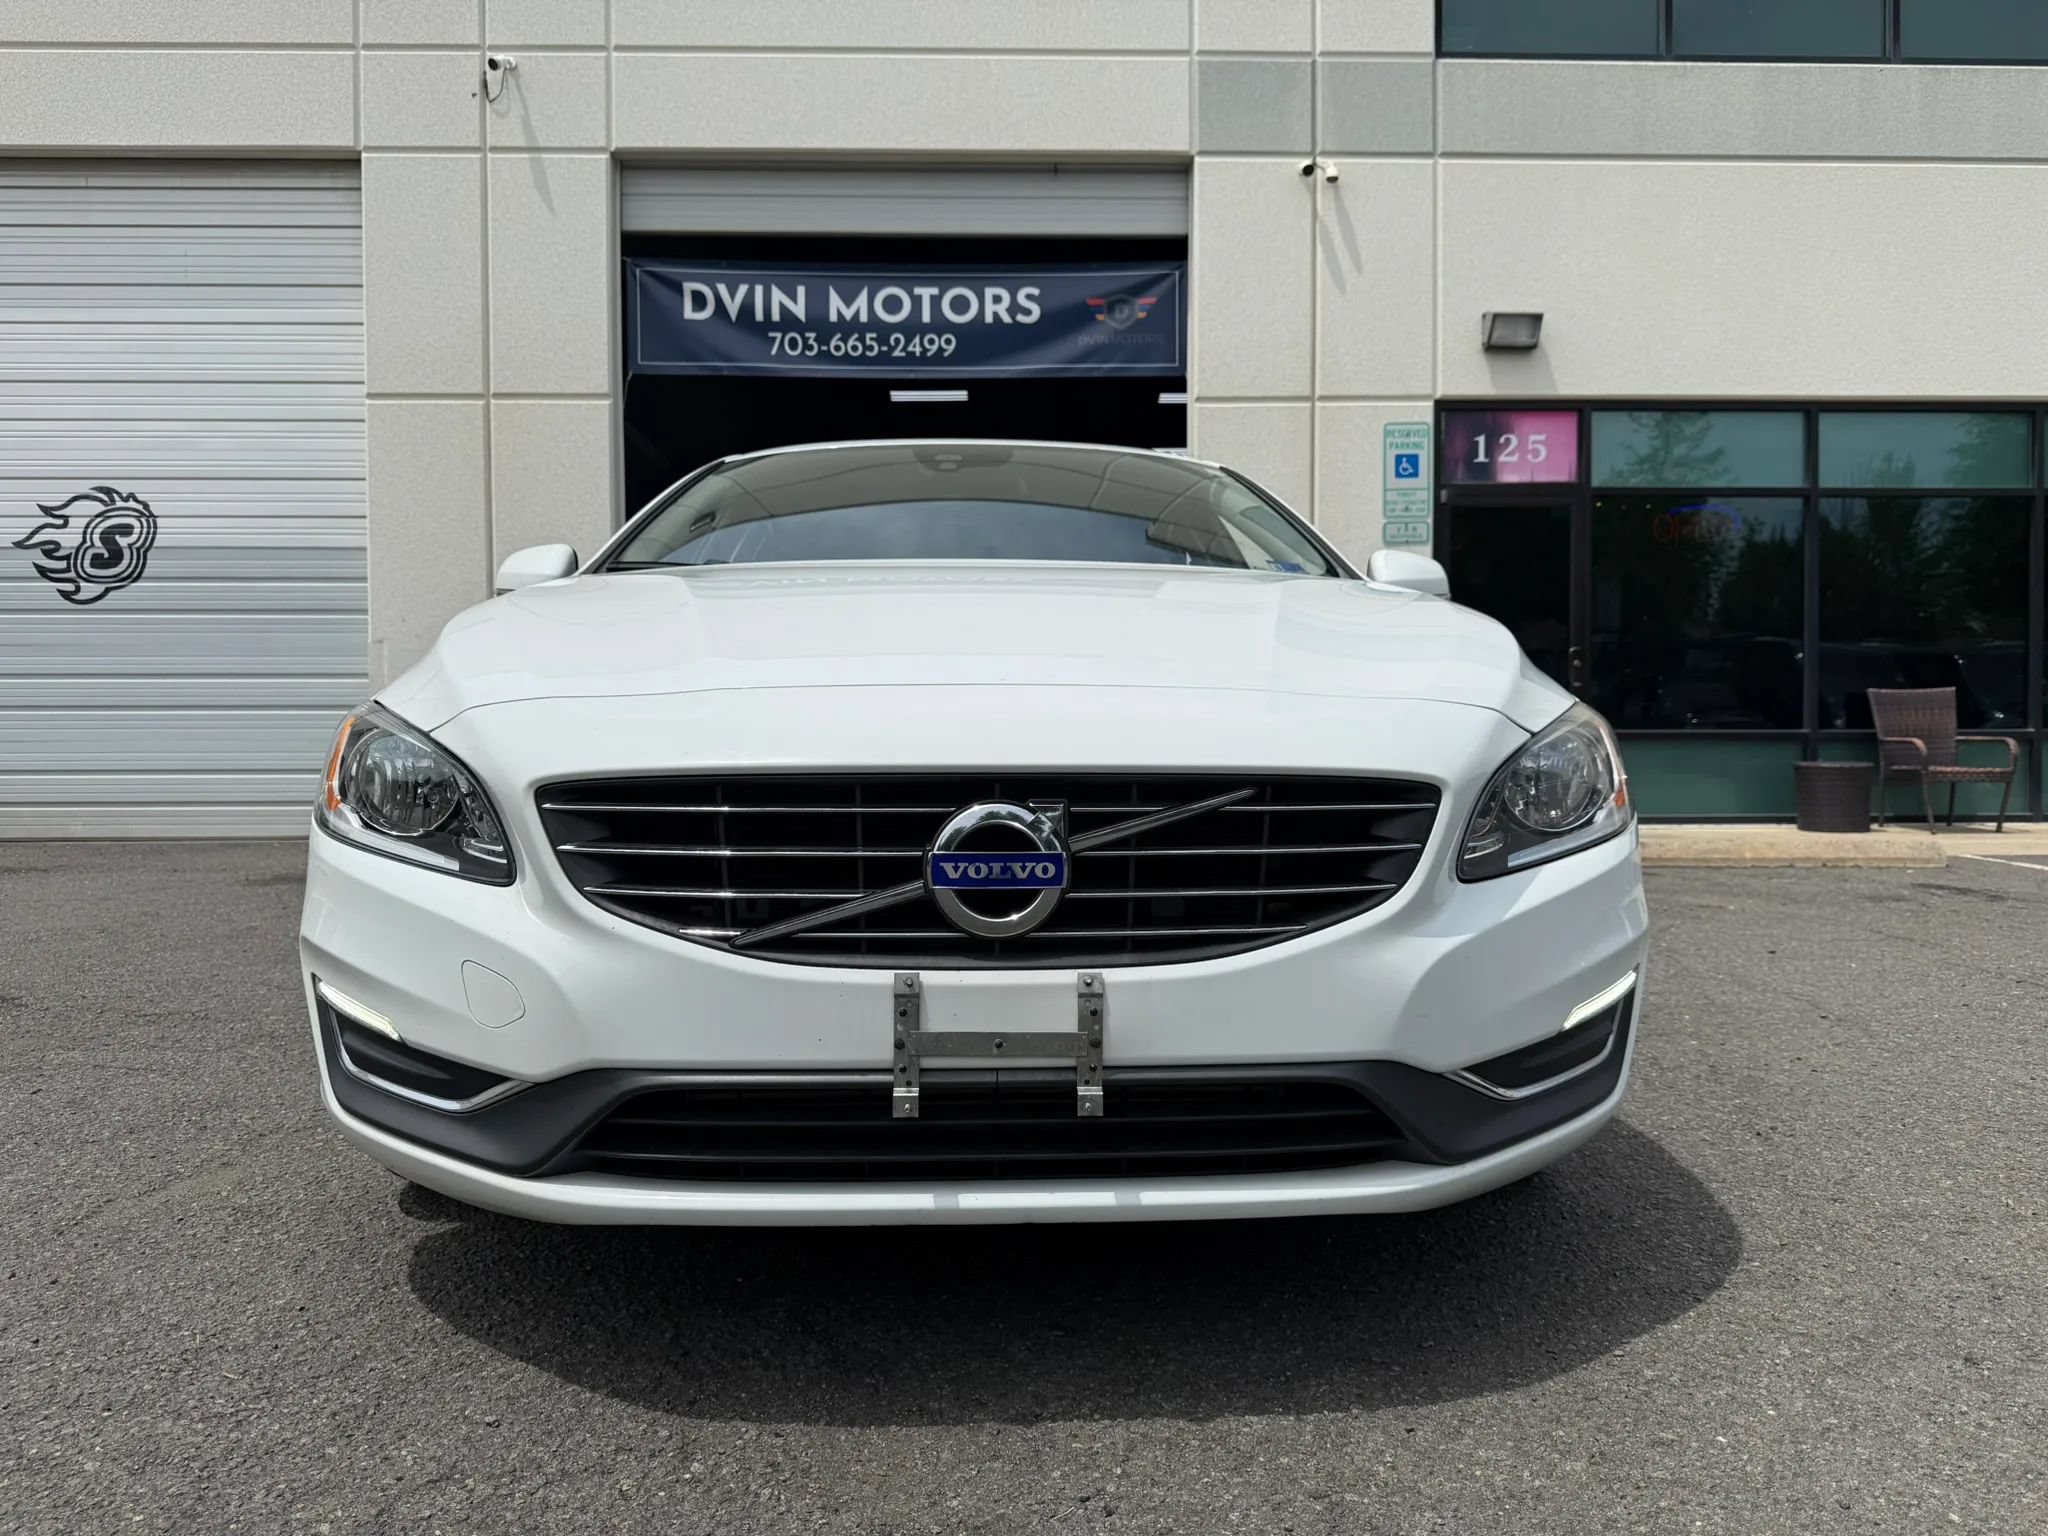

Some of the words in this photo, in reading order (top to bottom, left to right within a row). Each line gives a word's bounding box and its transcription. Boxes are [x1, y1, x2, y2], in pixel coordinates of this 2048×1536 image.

[682, 282, 806, 323] DVIN
[829, 285, 1041, 324] MOTORS
[768, 332, 957, 357] 703-665-2499
[1389, 441, 1425, 450] PARKING
[1472, 434, 1548, 463] 125
[939, 862, 1056, 879] VOLVO
